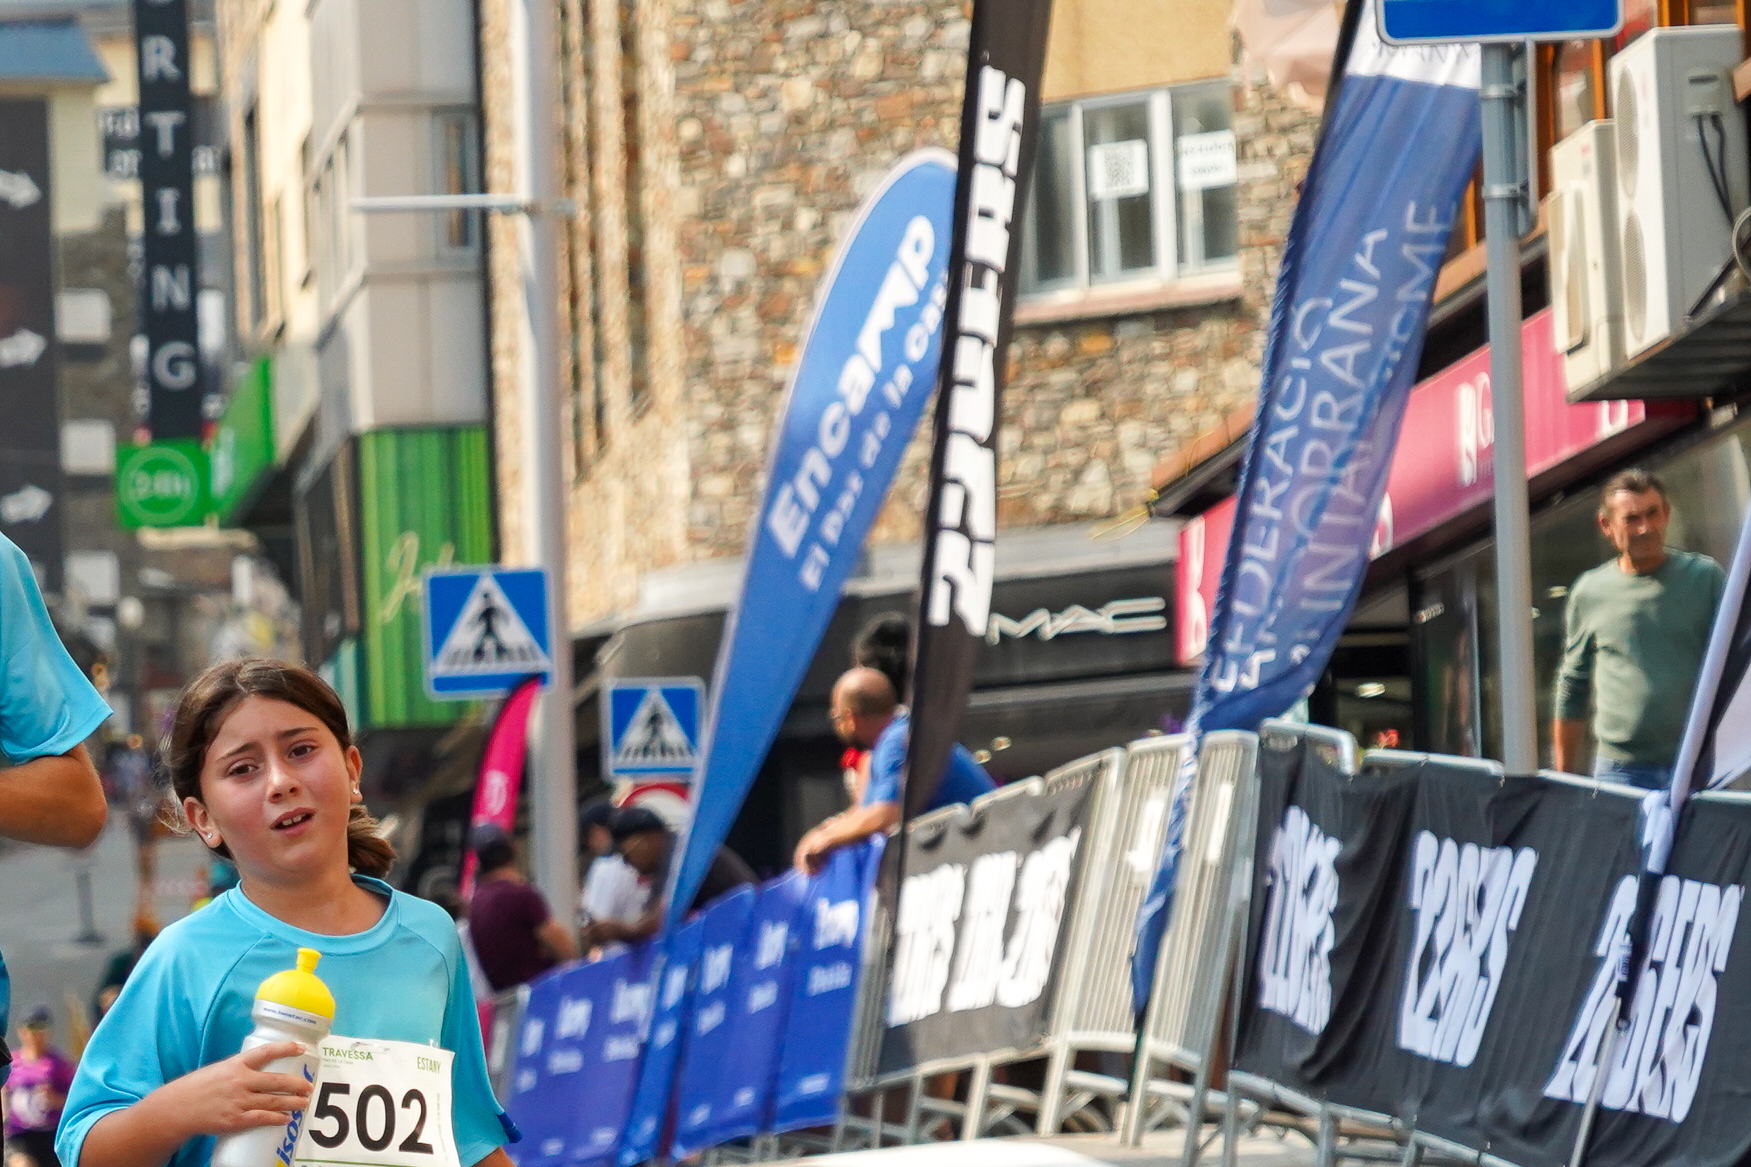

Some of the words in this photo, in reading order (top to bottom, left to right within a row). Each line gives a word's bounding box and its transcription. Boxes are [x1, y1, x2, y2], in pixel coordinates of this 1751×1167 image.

[140, 0, 199, 391] RTING
[766, 213, 936, 560] Encamp
[322, 1047, 374, 1061] TRAVESSA
[416, 1056, 442, 1075] ESTANY
[308, 1081, 434, 1155] 502
